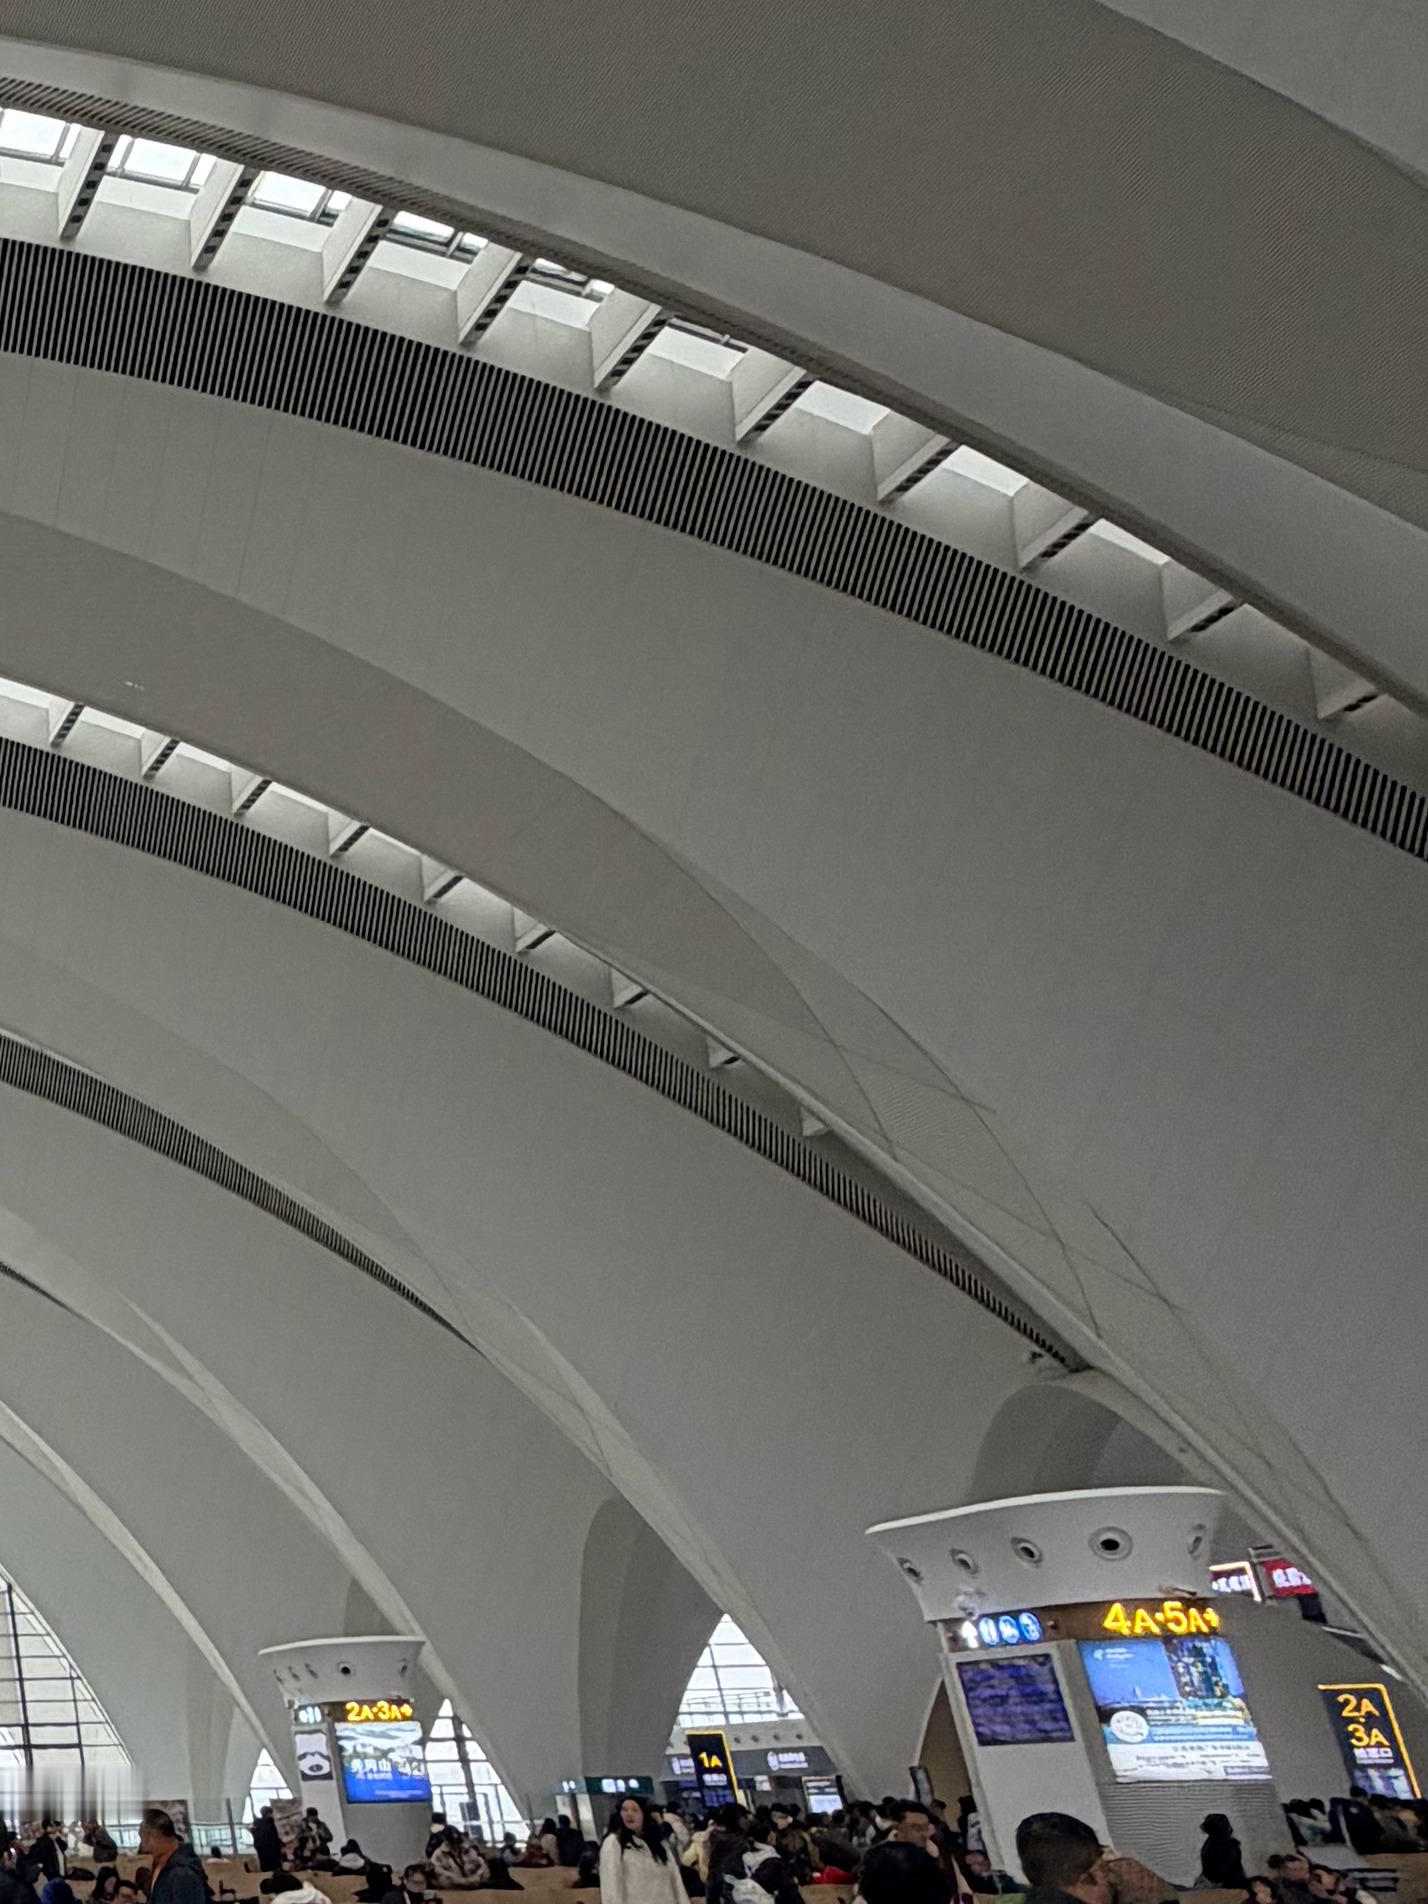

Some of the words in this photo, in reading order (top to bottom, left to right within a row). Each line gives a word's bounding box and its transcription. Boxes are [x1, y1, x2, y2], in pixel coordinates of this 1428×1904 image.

[1336, 1693, 1381, 1718] 2A
[1346, 1723, 1391, 1747] 3A
[698, 1751, 724, 1768] 1A
